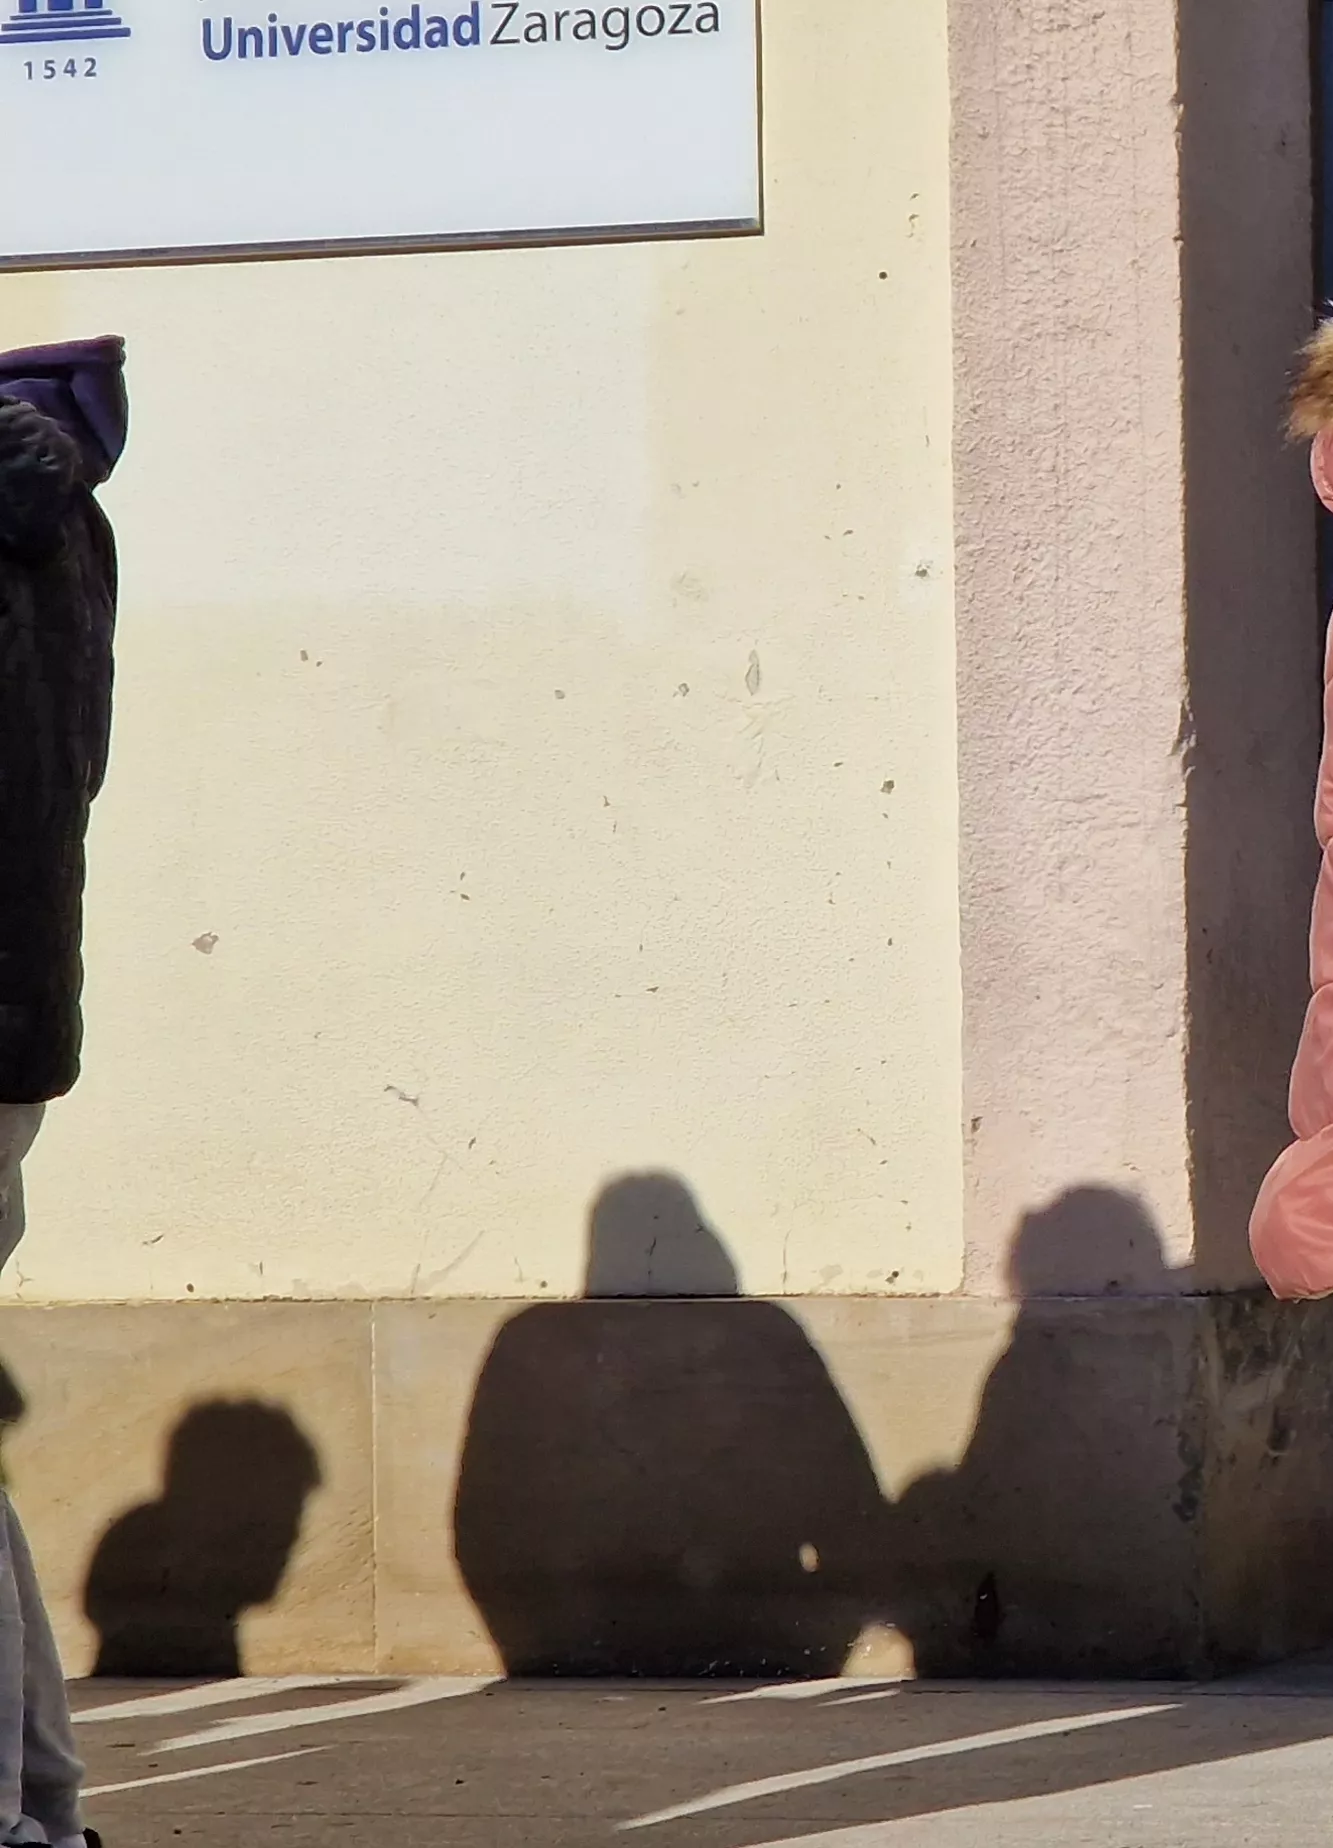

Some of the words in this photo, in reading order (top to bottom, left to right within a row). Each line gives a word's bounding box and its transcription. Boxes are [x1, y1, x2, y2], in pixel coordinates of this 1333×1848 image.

[202, 0, 482, 61] Universidad
[489, 0, 721, 51] Zaragoza
[24, 57, 97, 80] 1542
